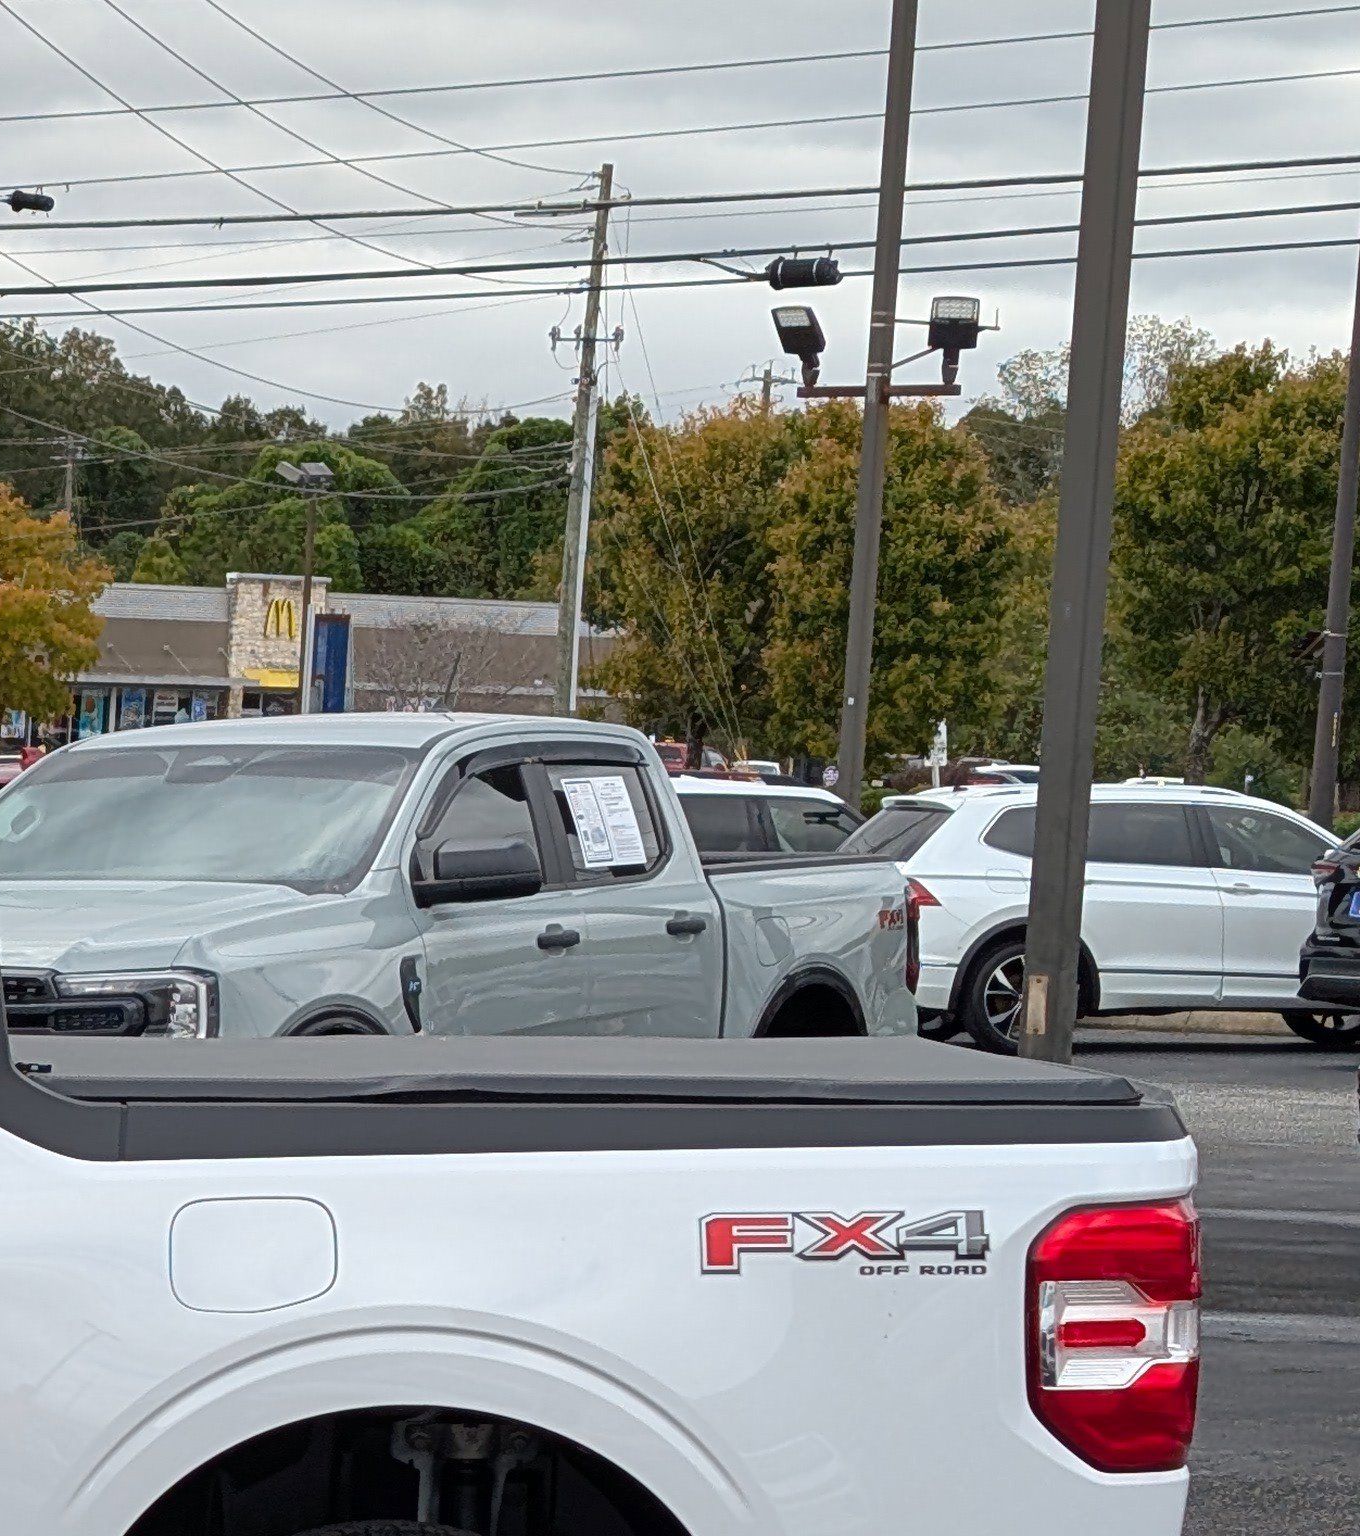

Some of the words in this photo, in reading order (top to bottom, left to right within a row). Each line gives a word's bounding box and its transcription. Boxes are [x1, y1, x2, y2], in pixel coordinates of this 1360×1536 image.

[700, 1210, 989, 1275] FX4
[859, 1265, 909, 1276] OFF
[919, 1265, 987, 1276] ROAD
